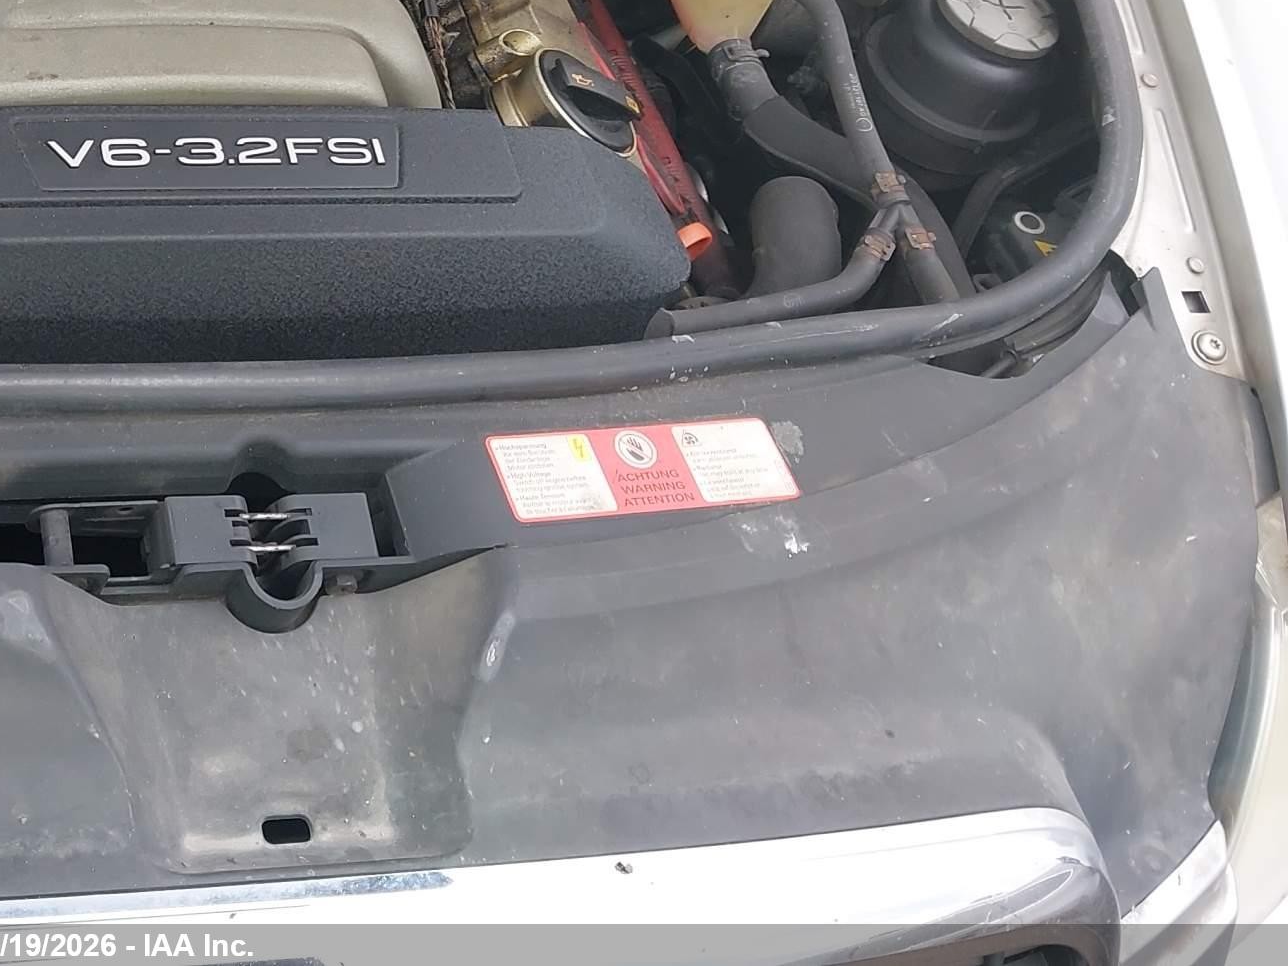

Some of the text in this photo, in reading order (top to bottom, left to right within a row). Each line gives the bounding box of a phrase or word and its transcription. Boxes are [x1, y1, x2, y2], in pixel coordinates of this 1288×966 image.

[47, 137, 386, 168] V6-3.2FSI
[618, 469, 679, 482] ACHTUNG
[620, 481, 686, 494] WARNING
[624, 492, 694, 506] ATTENTION
